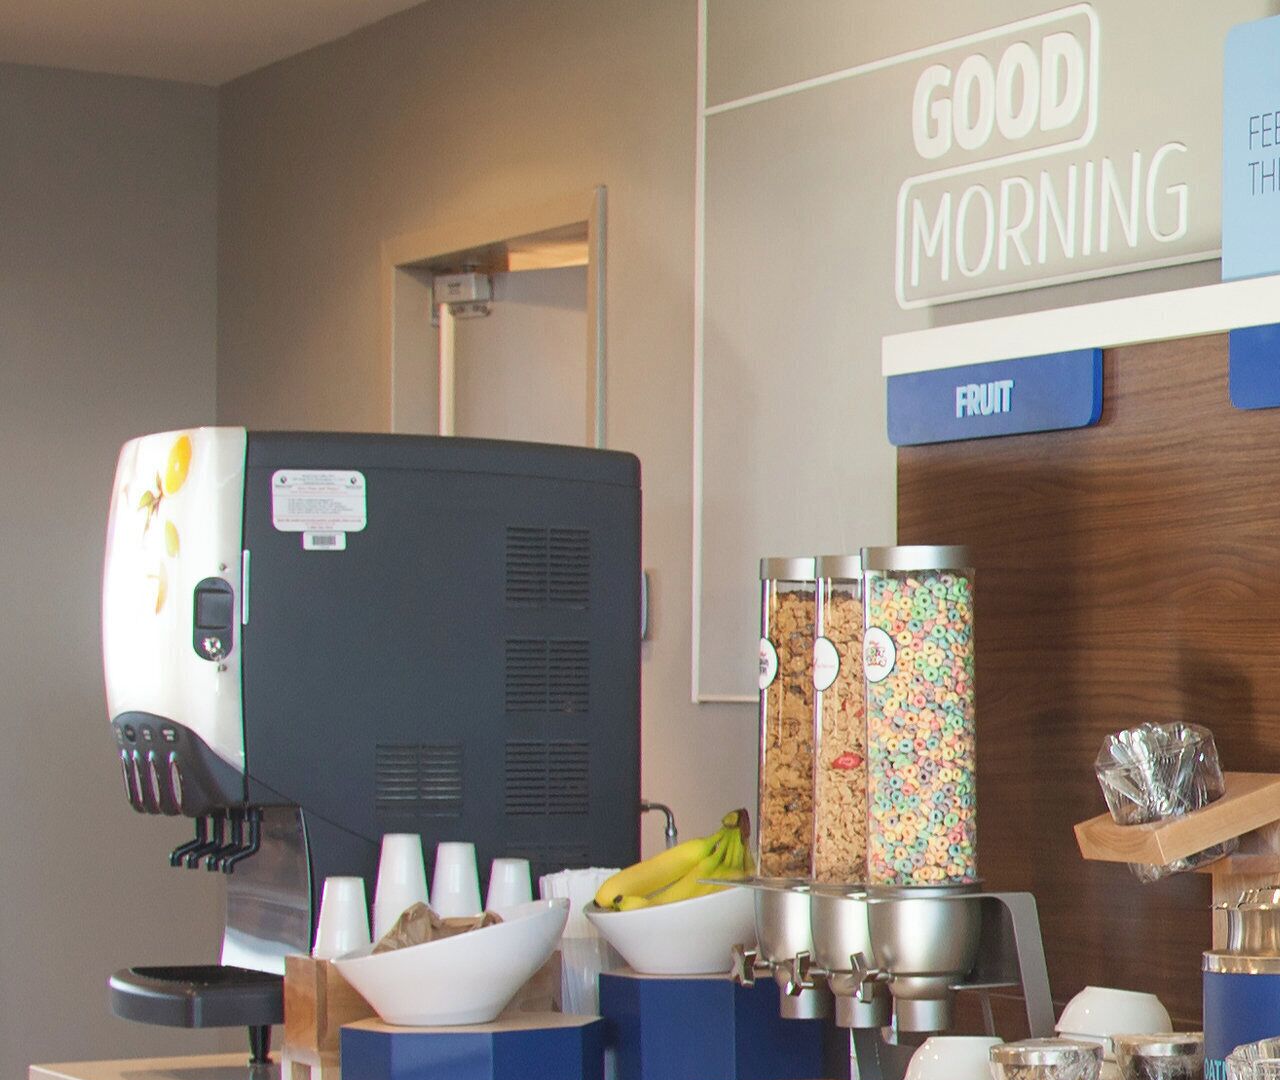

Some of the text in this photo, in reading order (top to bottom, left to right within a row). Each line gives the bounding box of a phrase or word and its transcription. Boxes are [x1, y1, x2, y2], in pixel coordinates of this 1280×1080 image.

[912, 31, 1084, 160] GOOD
[910, 141, 1188, 287] MORNING
[955, 379, 1014, 418] FRUIT
